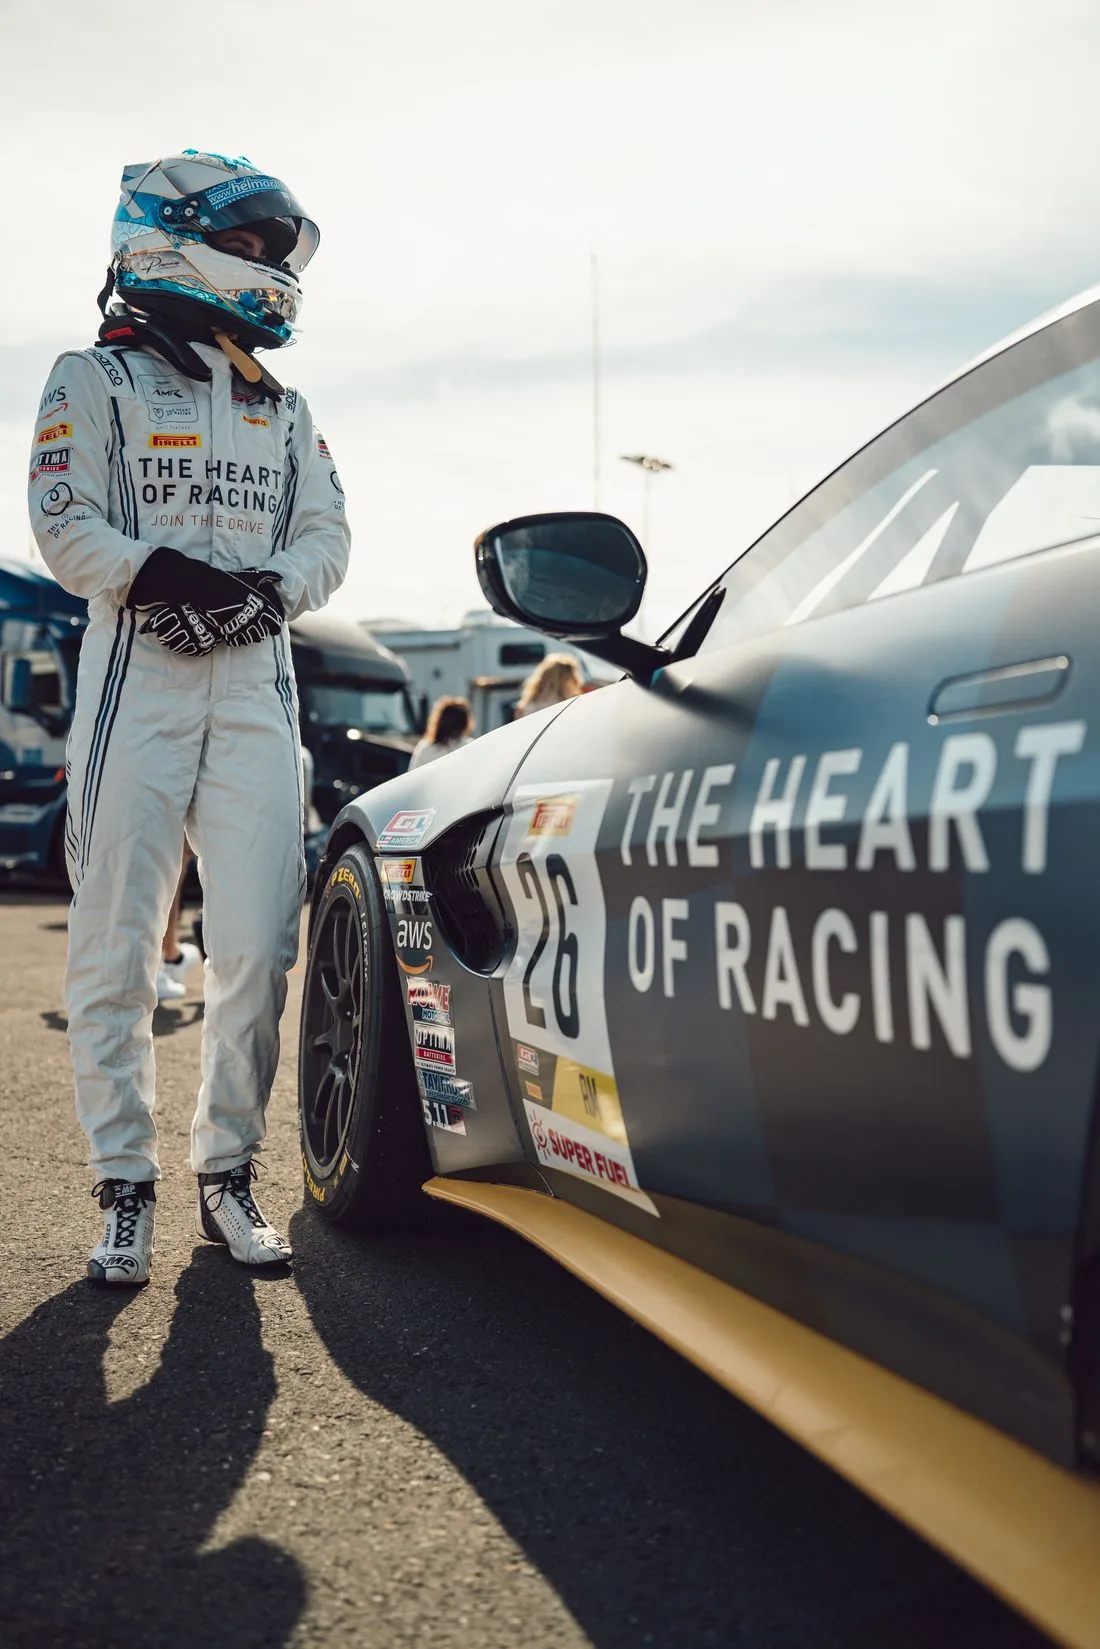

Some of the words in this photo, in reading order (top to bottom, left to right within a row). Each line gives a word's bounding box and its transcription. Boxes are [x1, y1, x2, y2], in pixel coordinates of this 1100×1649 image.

[152, 389, 183, 398] AMR
[152, 435, 197, 447] PIRELLI
[139, 458, 193, 479] THE
[205, 460, 281, 490] HEART
[142, 484, 177, 505] OF
[188, 484, 278, 514] RACING
[151, 514, 185, 527] JOIN
[191, 514, 223, 528] THE
[228, 517, 265, 535] DRIVE
[225, 593, 264, 634] freem
[620, 763, 736, 867] THE
[749, 719, 1087, 874] HEART
[383, 888, 433, 902] CROWDSTRIKE
[396, 919, 433, 950] aws
[516, 852, 581, 1040] 26
[628, 896, 689, 998] OF
[714, 902, 1054, 1072] RACING
[416, 1029, 453, 1051] OPTIMA
[424, 1050, 446, 1062] BATTERIES
[423, 1099, 451, 1129] 5.11
[548, 1128, 596, 1175] SUPER
[594, 1151, 630, 1187] FUEL
